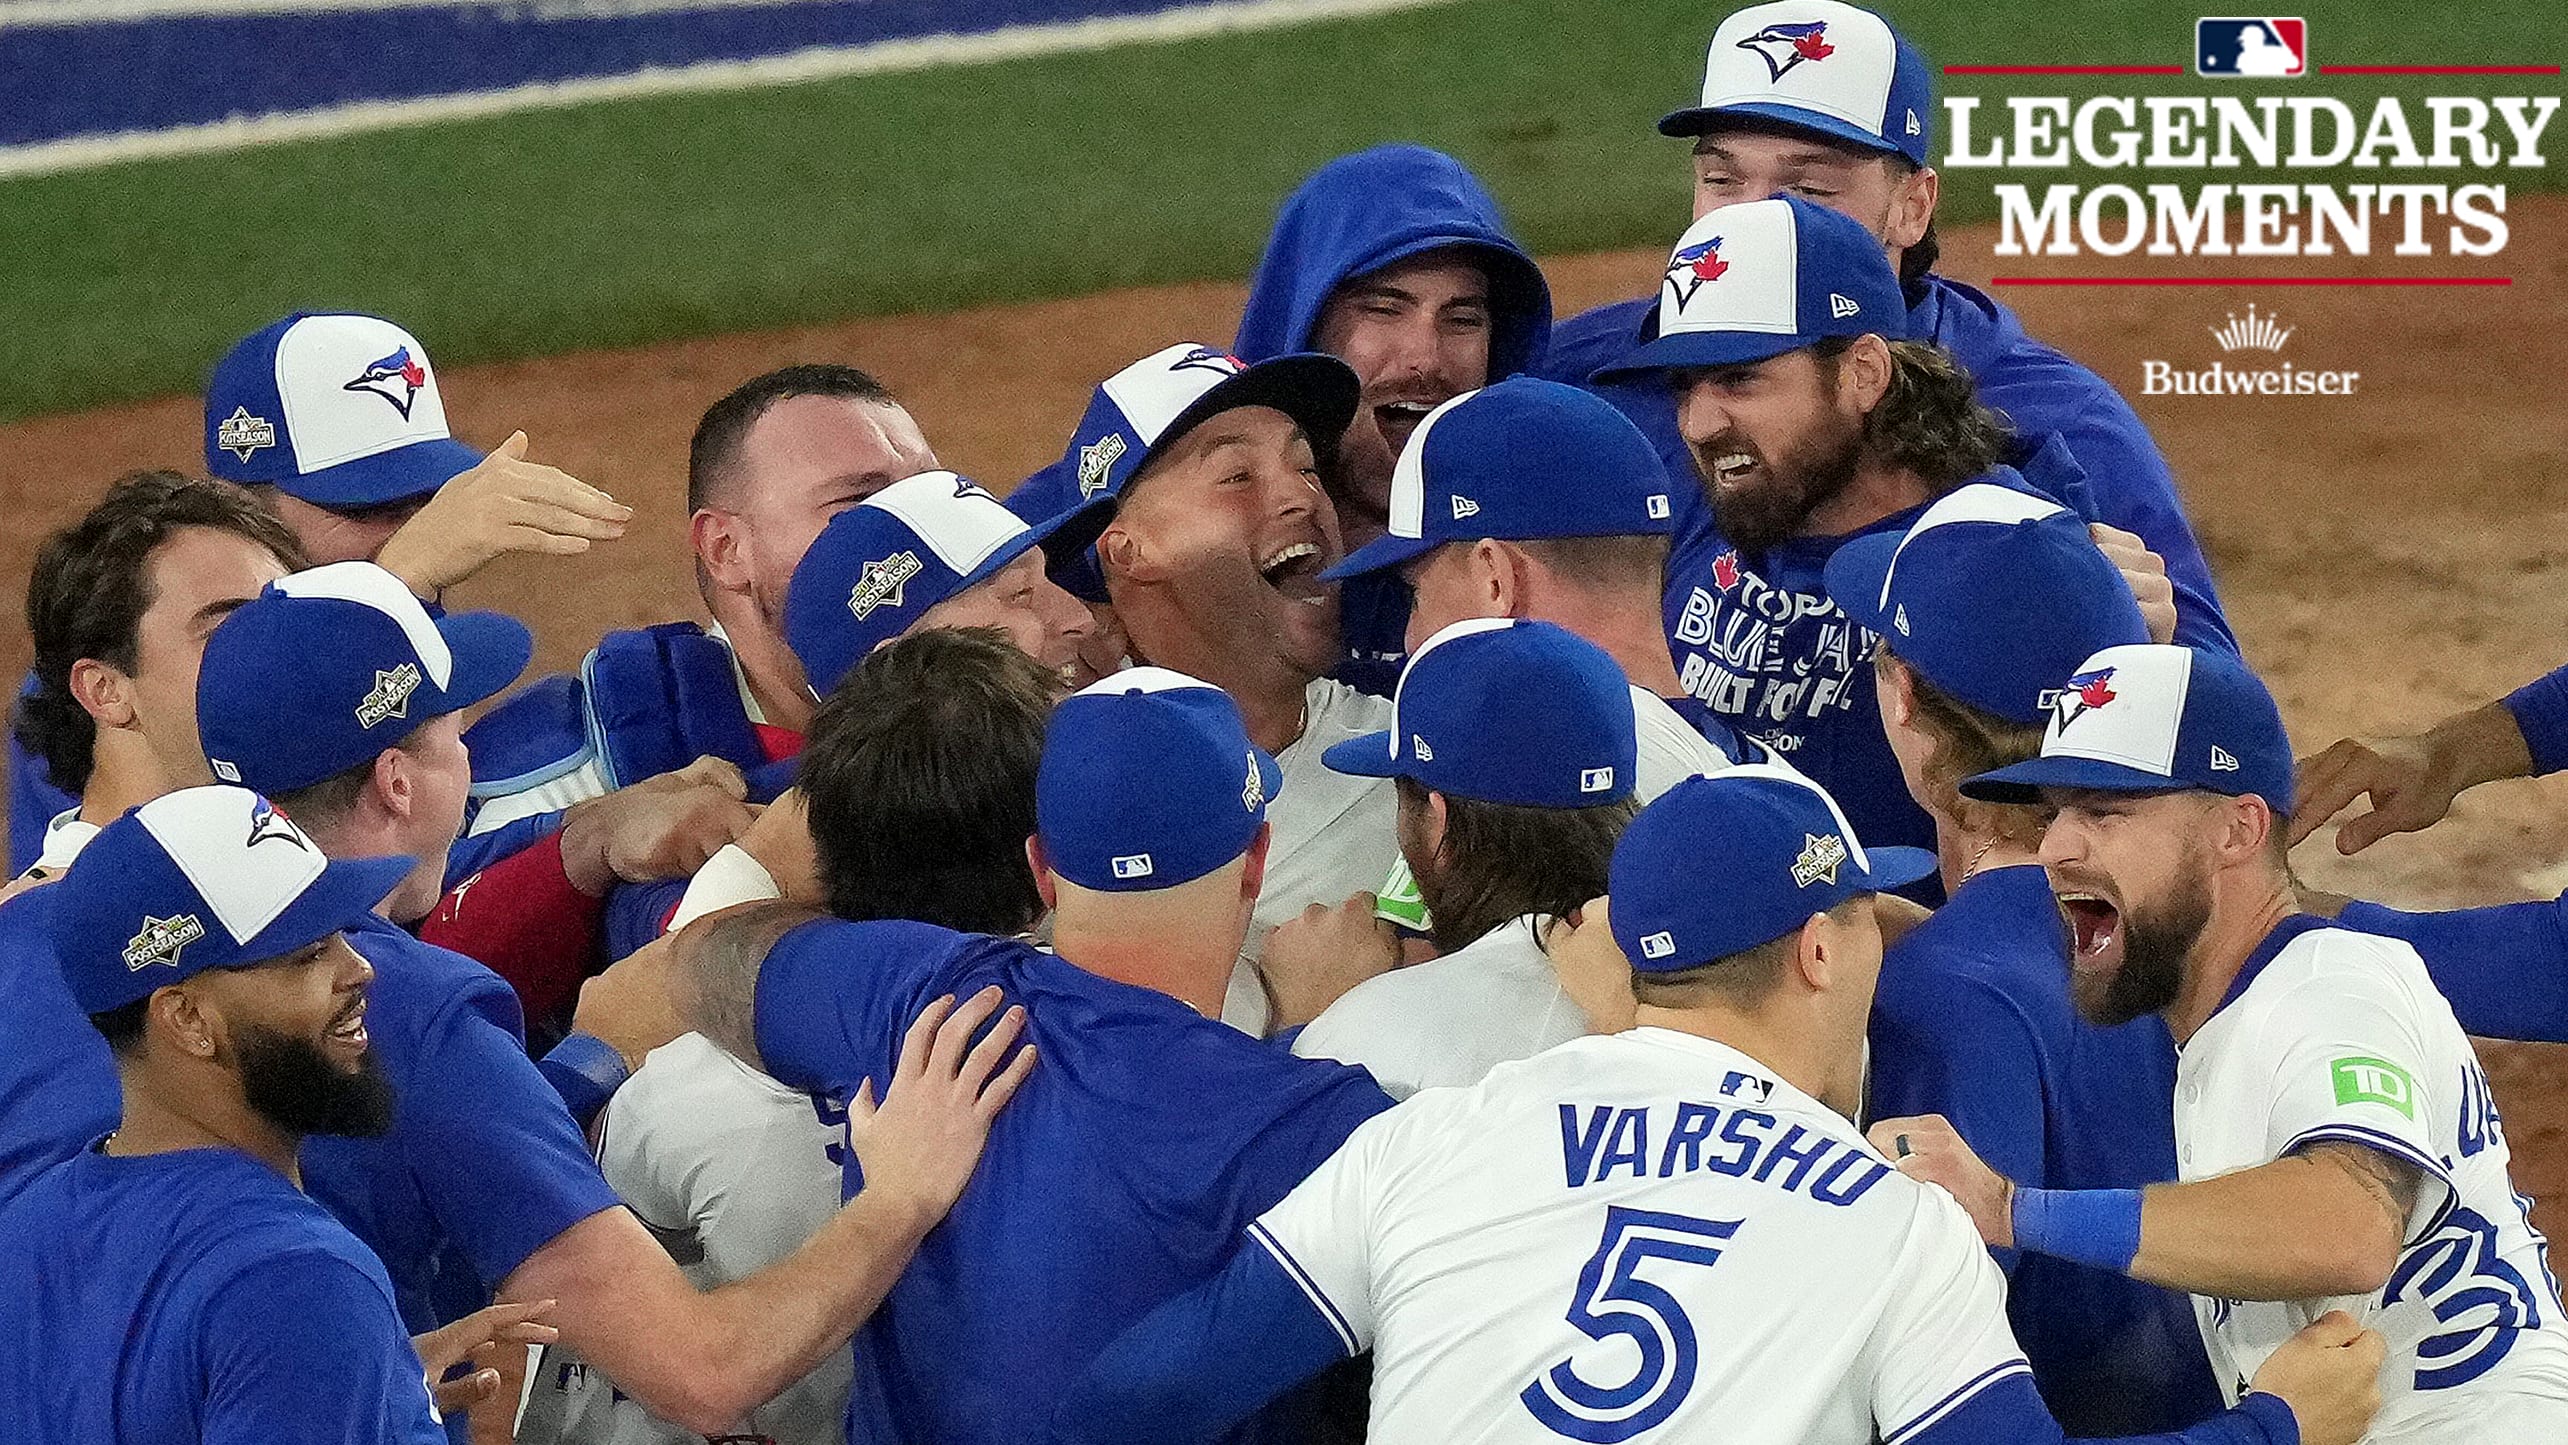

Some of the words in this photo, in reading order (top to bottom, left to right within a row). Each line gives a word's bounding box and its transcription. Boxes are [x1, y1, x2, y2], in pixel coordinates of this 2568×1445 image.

[851, 555, 918, 614] POSTSEASON
[359, 668, 419, 725] POSTSEASON
[1680, 652, 1755, 714] BUILT
[126, 921, 200, 967] POSTSEASON
[2339, 1065, 2409, 1104] TD
[1559, 1102, 1891, 1207] VARSHO
[1519, 1205, 1746, 1445] 5
